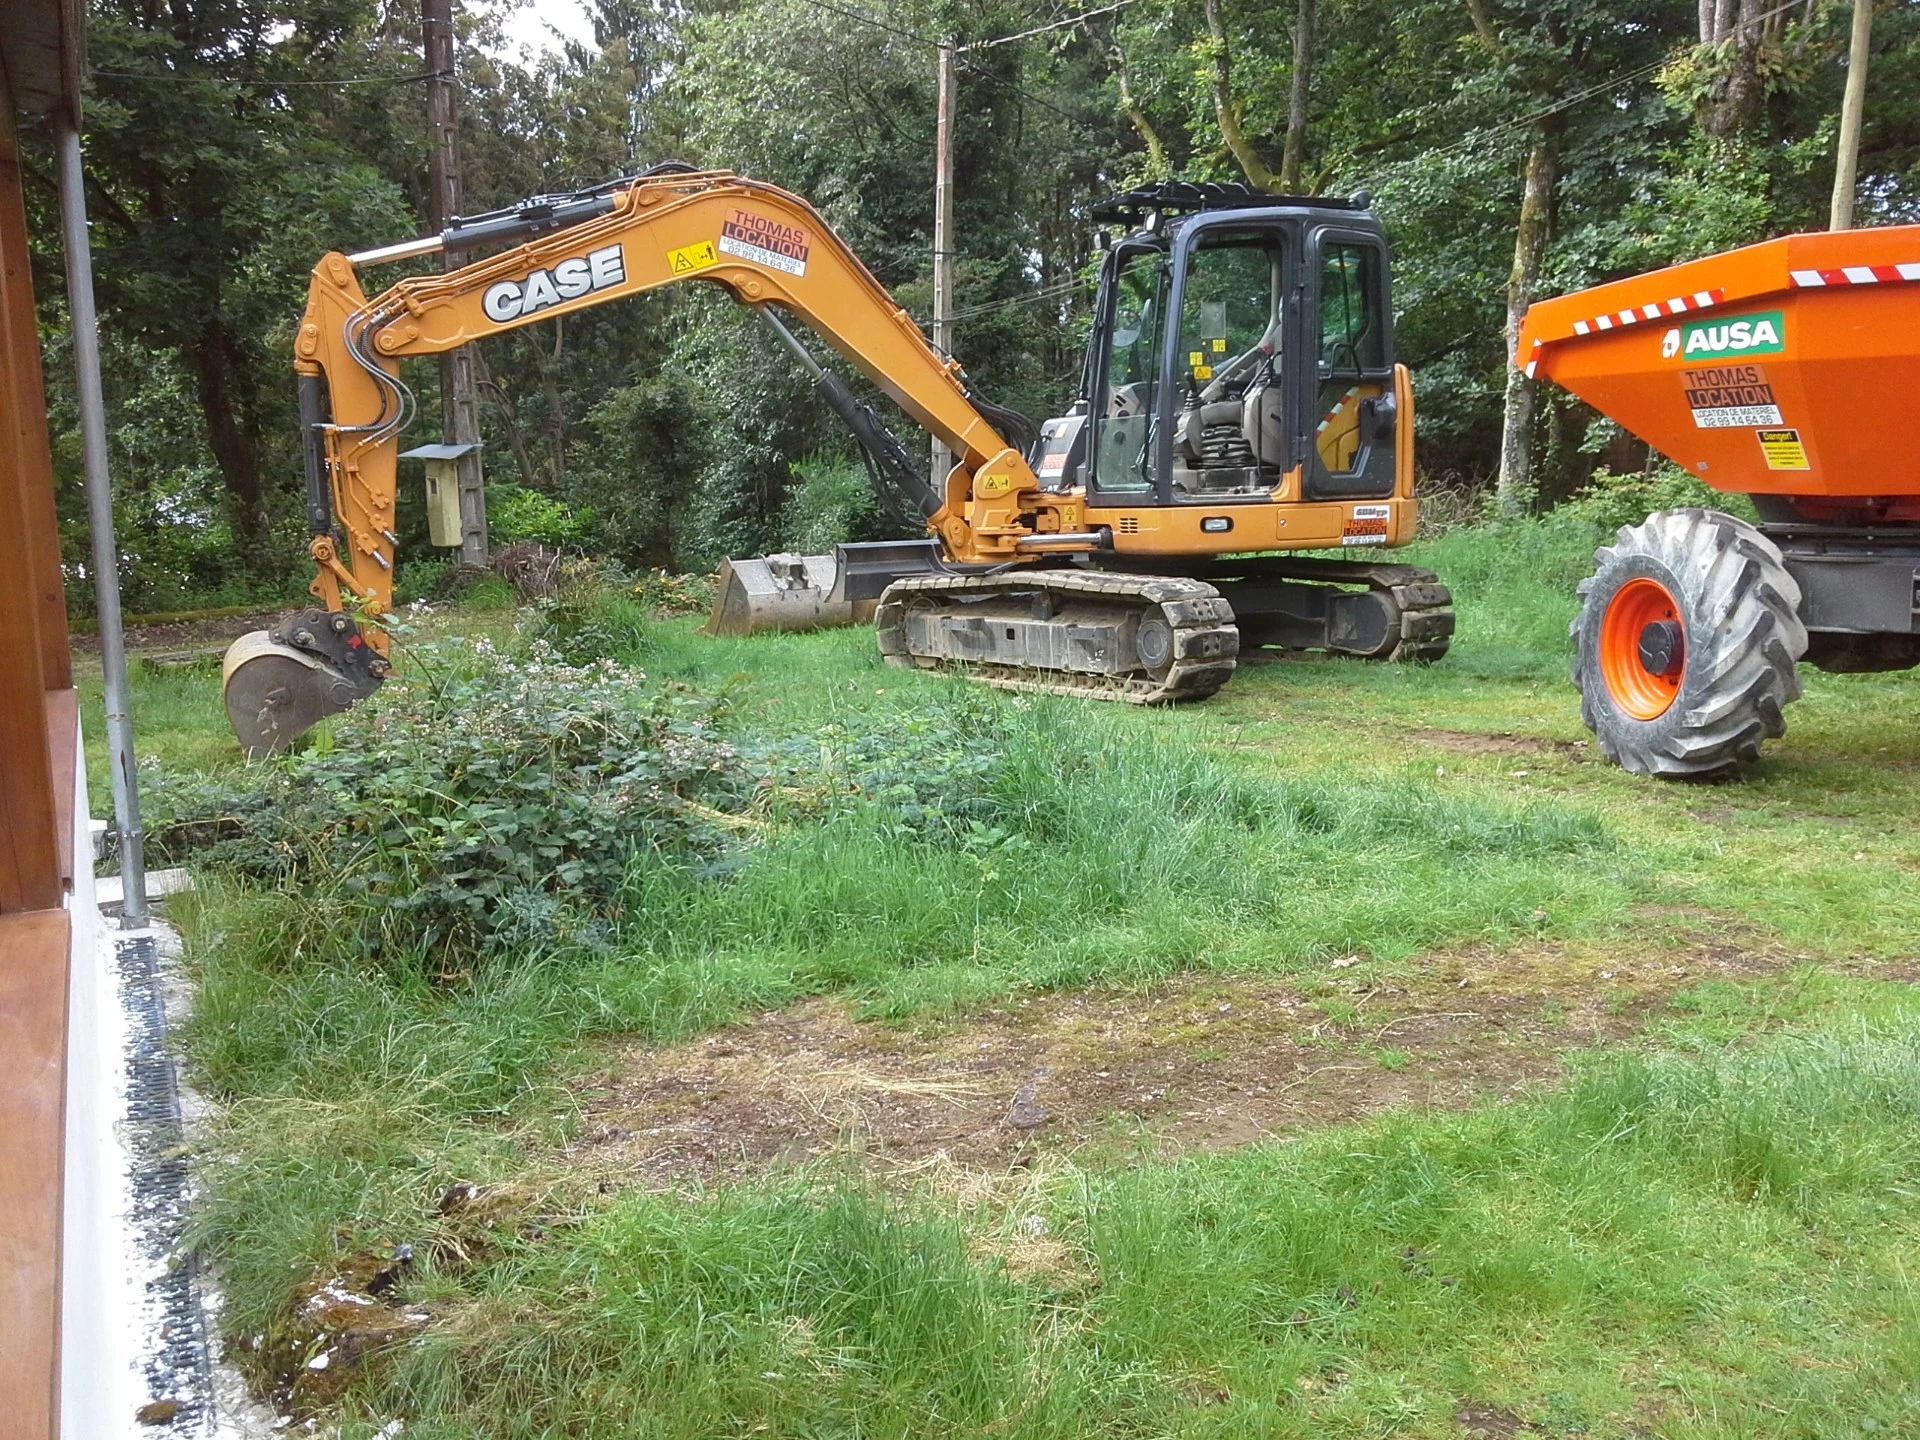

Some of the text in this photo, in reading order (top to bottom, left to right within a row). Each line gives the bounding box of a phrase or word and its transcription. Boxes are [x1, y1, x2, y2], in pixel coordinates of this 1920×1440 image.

[735, 210, 804, 244] THOMAS
[723, 238, 757, 253] LOCATION
[758, 248, 767, 256] DE
[725, 223, 805, 260] LOCATION
[728, 246, 796, 273] 02 99 14 64 36
[484, 245, 625, 321] CASE
[1685, 320, 1780, 354] AUSA
[1685, 366, 1758, 388] THOMAS
[1687, 387, 1772, 407] LOCATION
[1695, 408, 1729, 418] LOCATION
[1730, 408, 1740, 416] DE
[1703, 414, 1774, 427] 02 99 14 64 36
[1345, 527, 1385, 535] LOCATION
[1348, 518, 1384, 528] THOMAS
